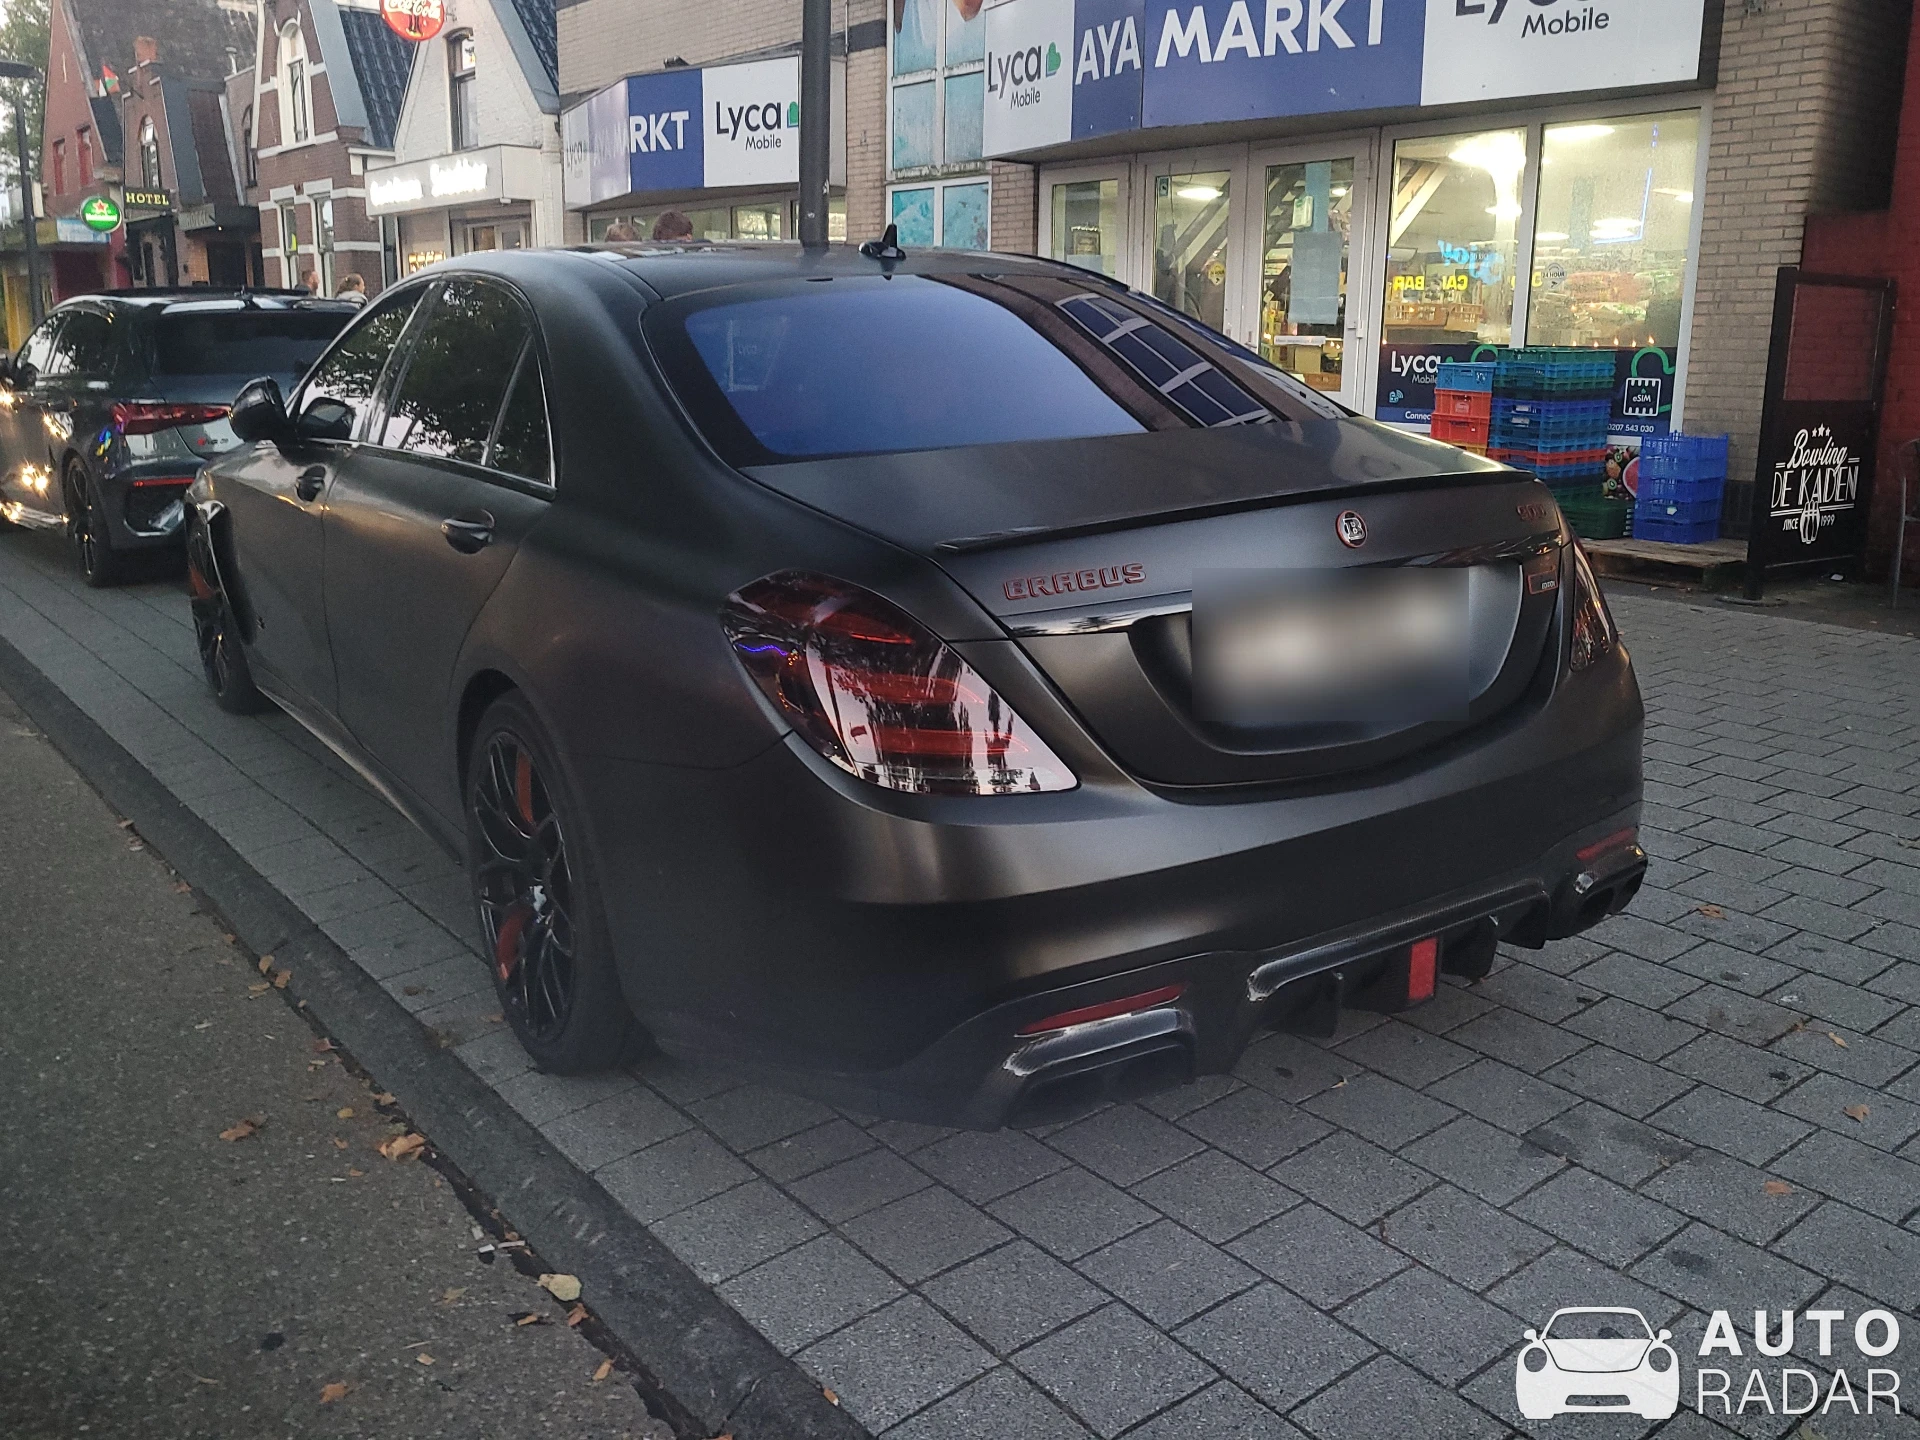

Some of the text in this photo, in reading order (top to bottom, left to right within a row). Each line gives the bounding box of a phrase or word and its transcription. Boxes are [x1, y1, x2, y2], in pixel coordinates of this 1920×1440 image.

[1521, 6, 1610, 39] Mobile
[1075, 0, 1384, 85] AYA MARKT
[987, 45, 1042, 100] Lyca
[1010, 86, 1041, 110] Mobile
[715, 101, 782, 141] Lyca
[745, 133, 782, 151] Mobile
[125, 191, 170, 206] HOTEL
[1390, 350, 1441, 377] Lyca
[1411, 373, 1438, 384] Mobile
[1632, 394, 1652, 403] eSIM
[1625, 424, 1639, 432] 543
[1640, 425, 1654, 433] 030
[1786, 428, 1848, 477] Bowling
[1771, 465, 1859, 508] DE KADEN
[1782, 514, 1836, 531] SINCE 1999
[1003, 562, 1147, 600] BRABUS
